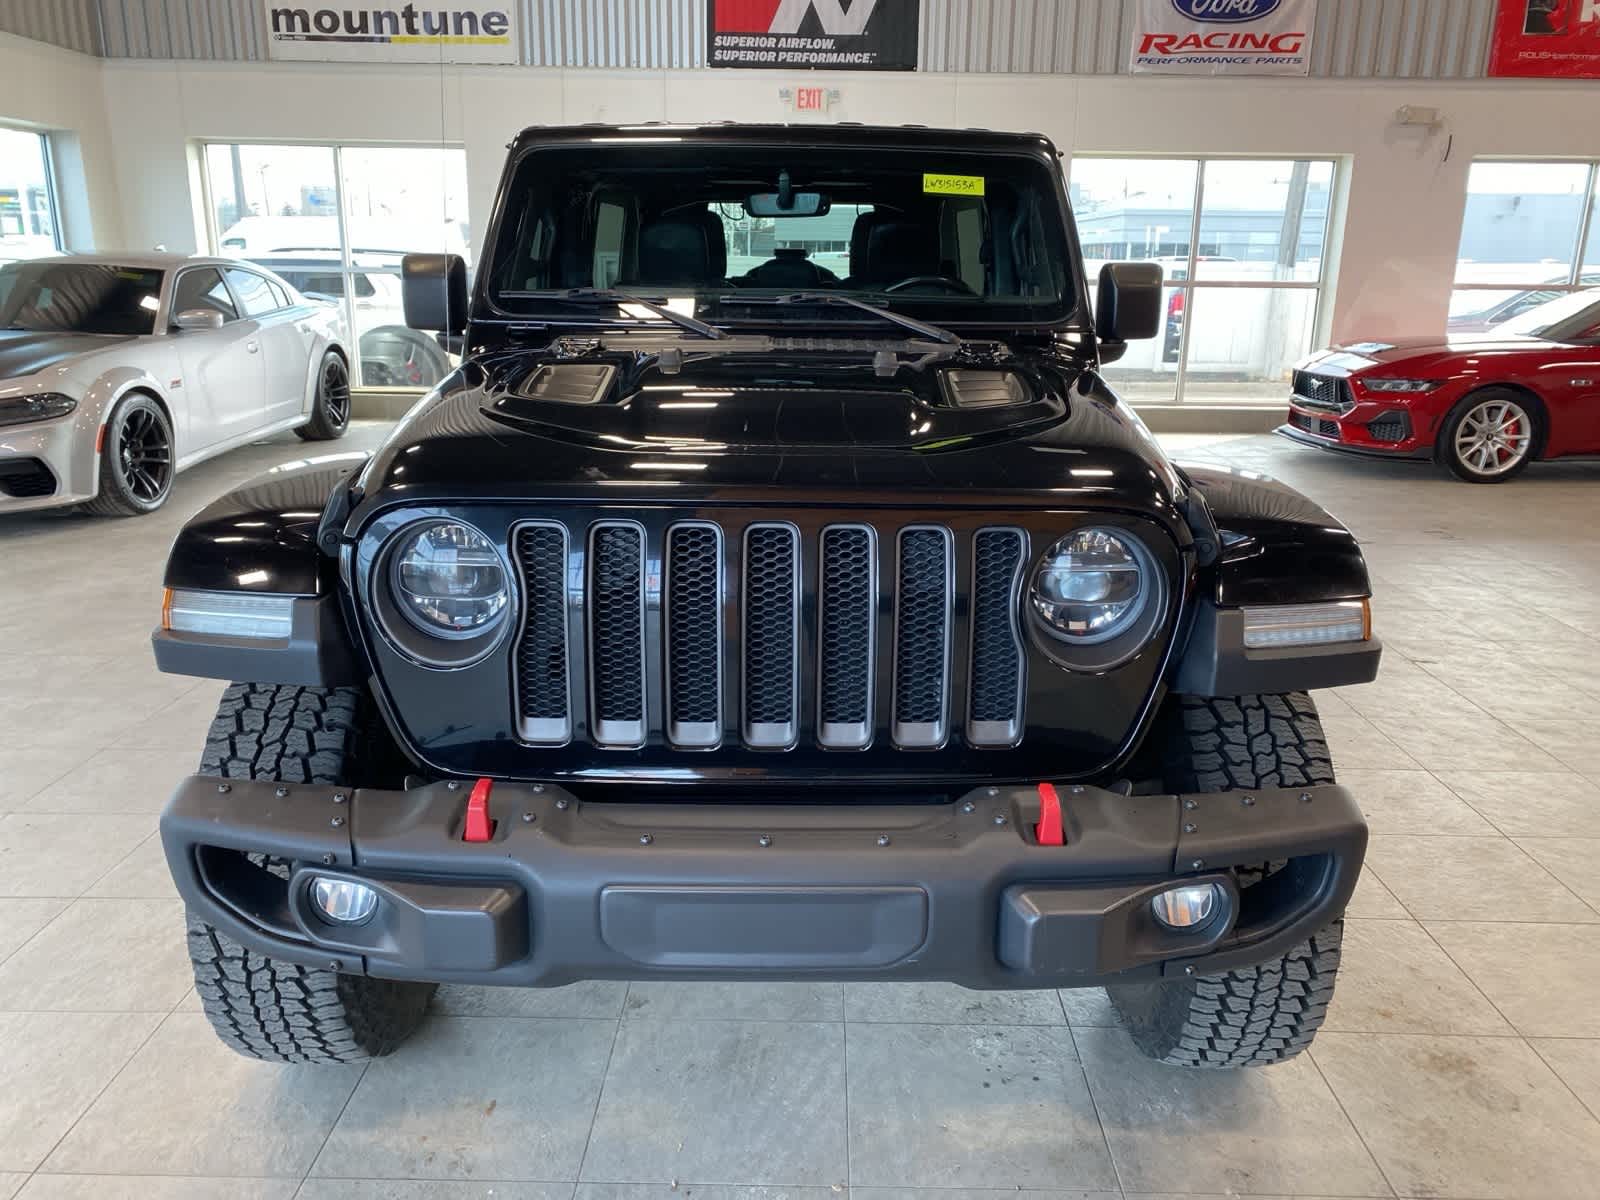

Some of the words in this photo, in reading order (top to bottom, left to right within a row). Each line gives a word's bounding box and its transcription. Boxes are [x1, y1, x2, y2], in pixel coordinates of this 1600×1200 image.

[271, 3, 509, 36] mountune
[714, 35, 777, 48] SUPERIOR
[777, 37, 836, 50] AIRFLOW.
[1139, 33, 1305, 54] RACING
[713, 49, 777, 62] SUPERIOR
[1137, 57, 1251, 65] PERFORMANCE
[1255, 57, 1303, 65] PARTS
[797, 88, 823, 109] EXIT
